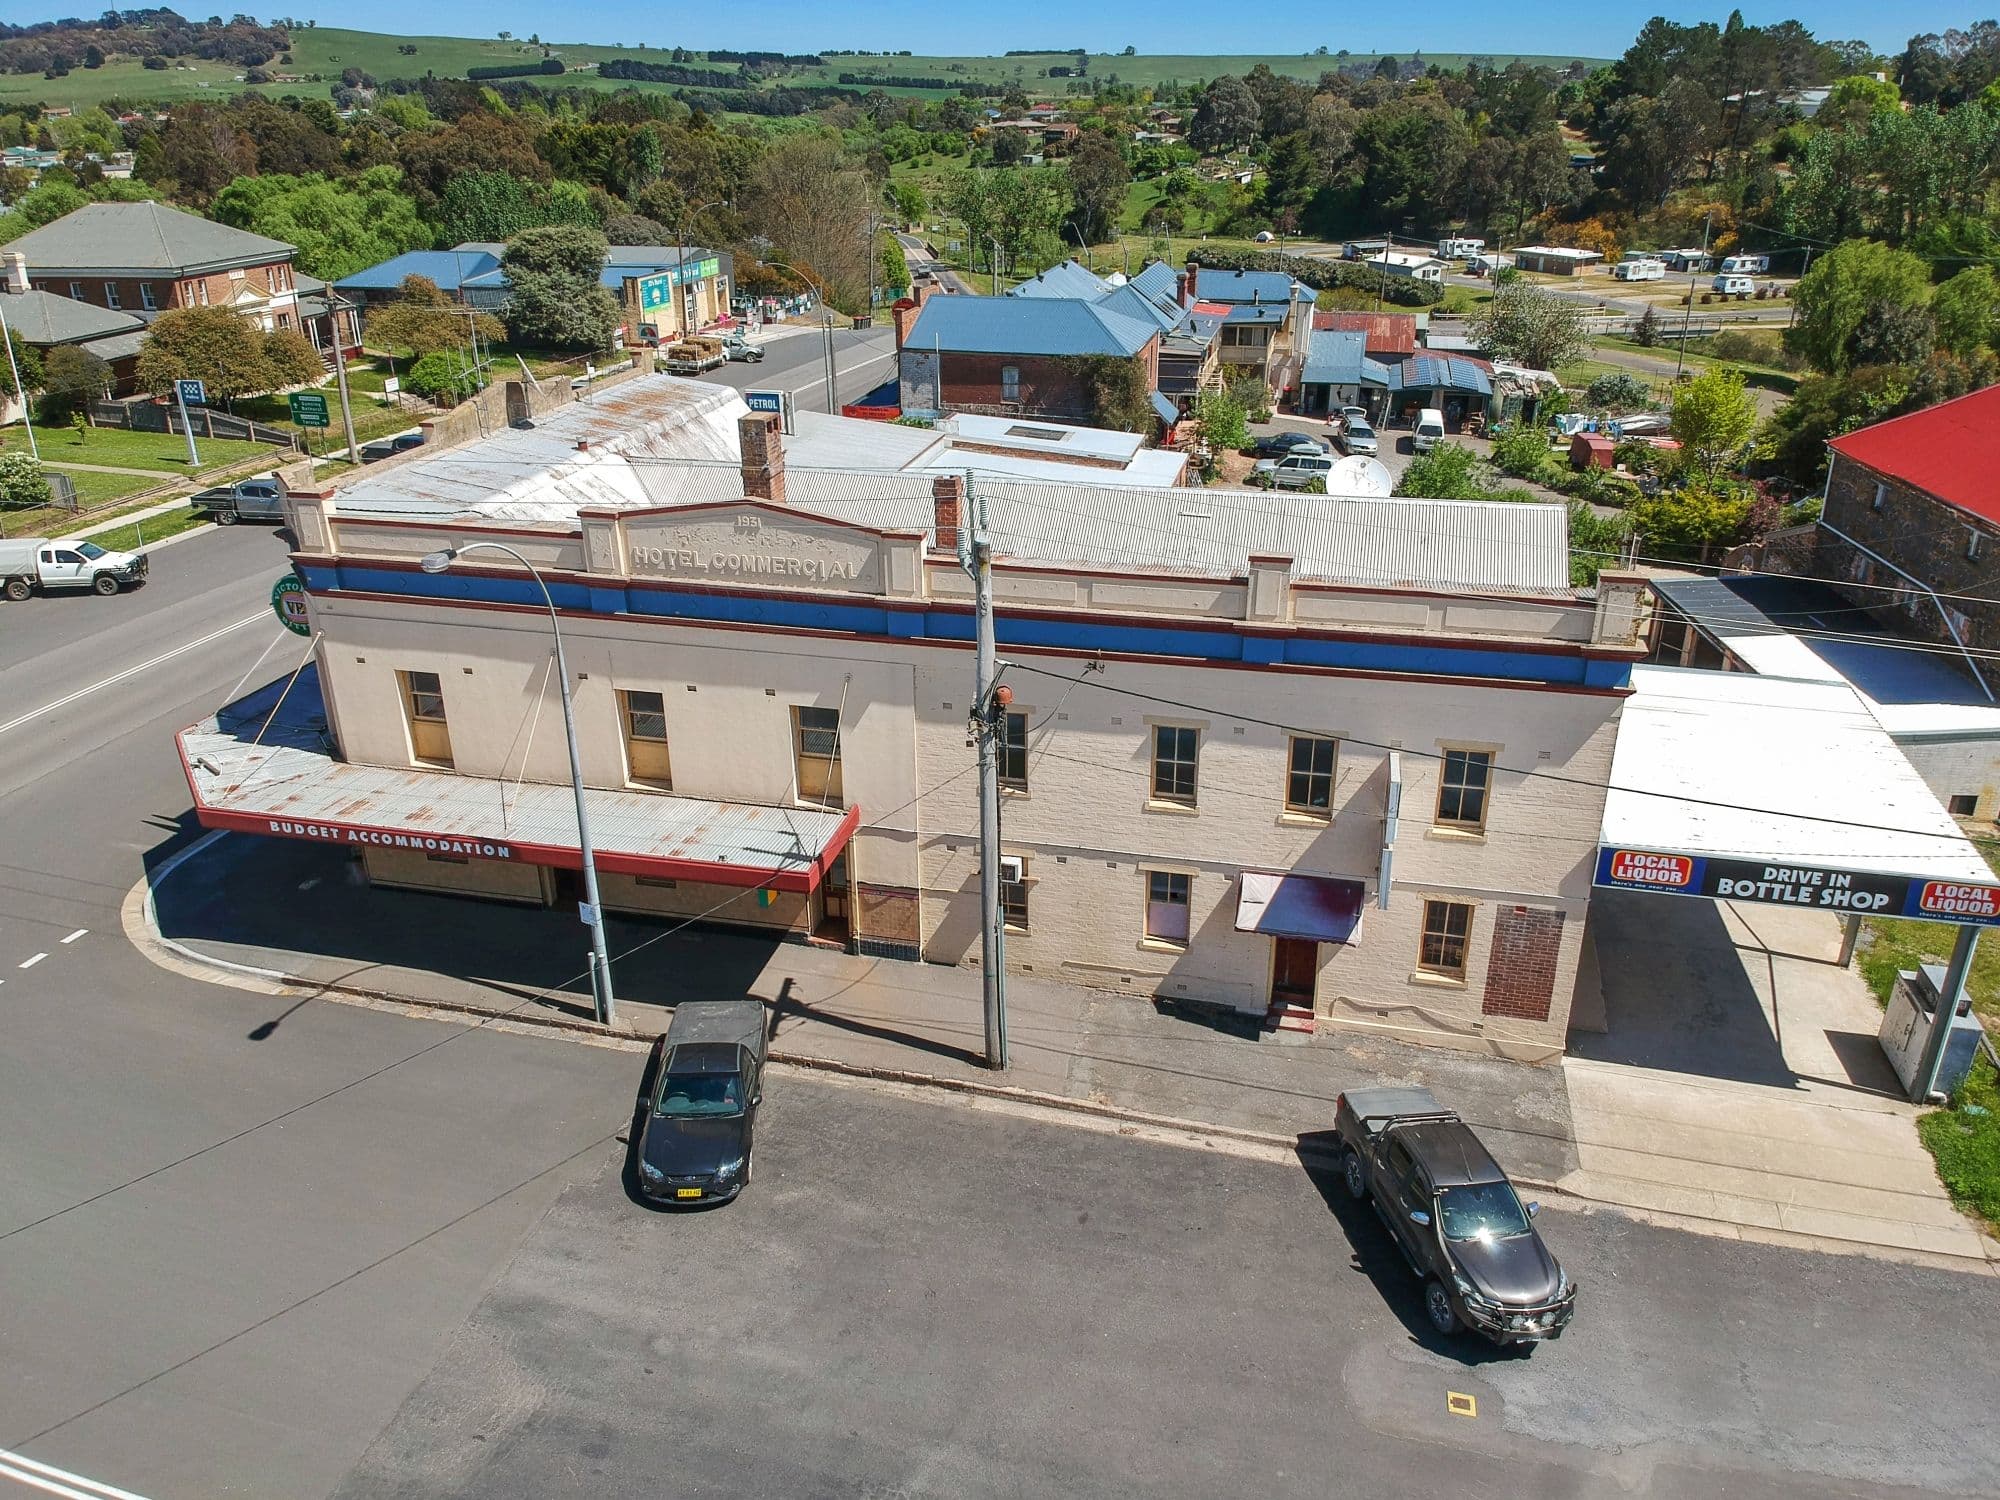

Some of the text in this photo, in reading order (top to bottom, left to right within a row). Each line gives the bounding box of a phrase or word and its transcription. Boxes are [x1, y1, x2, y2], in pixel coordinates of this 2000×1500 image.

[748, 399, 778, 409] PETROL
[737, 515, 761, 528] 1931
[633, 546, 858, 580] HOTEL COMMERCIAL
[274, 583, 304, 600] VICTO
[269, 821, 510, 858] BUDGET ACCOMMODATION
[1624, 853, 1679, 870] LOCAL
[1763, 867, 1851, 888] DRIVE IN
[1717, 878, 1890, 910] BOTTLE SHOP
[1935, 885, 1992, 901] LOCAL
